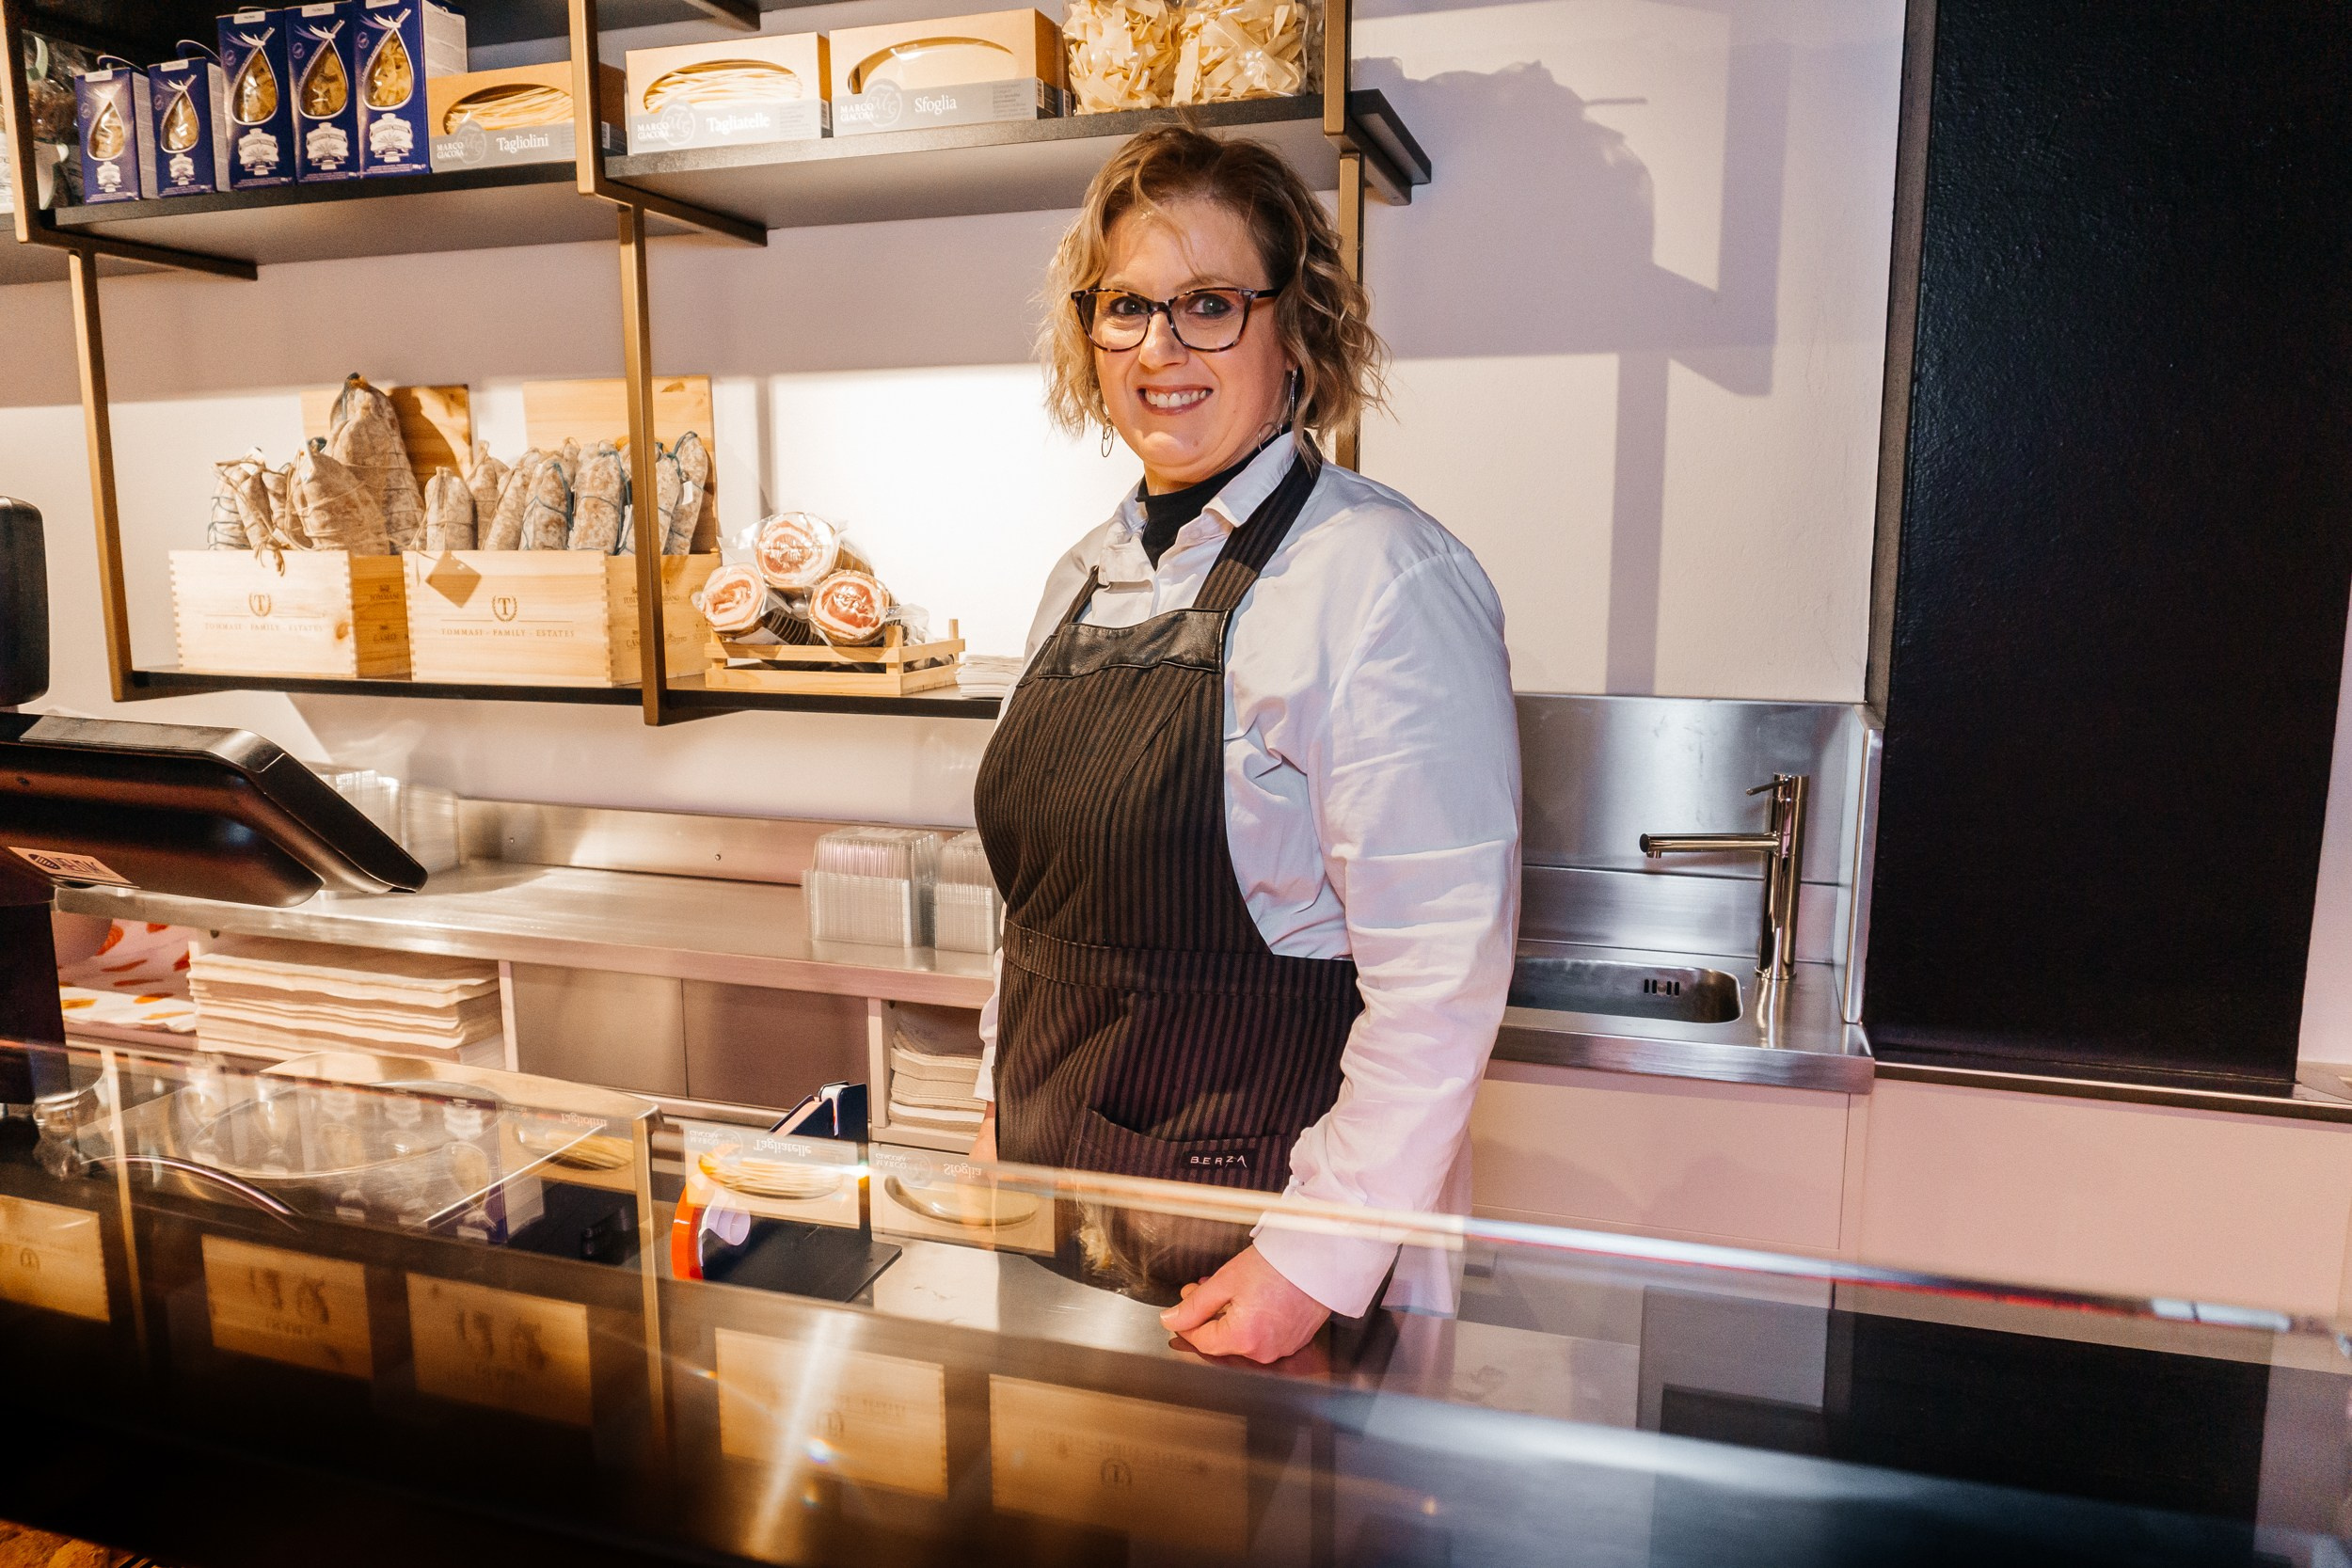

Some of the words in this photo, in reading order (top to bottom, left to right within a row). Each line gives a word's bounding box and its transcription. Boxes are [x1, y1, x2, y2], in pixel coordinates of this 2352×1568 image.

[840, 103, 873, 113] MARCO
[914, 94, 958, 115] Sfoglia
[637, 121, 669, 132] MARCO
[706, 112, 771, 135] Tagliatelle
[437, 142, 464, 151] MARCO
[496, 134, 548, 154] Tagliolini
[498, 597, 511, 616] T
[289, 624, 324, 632] ESTATES
[536, 629, 575, 638] ESTATES
[1190, 1155, 1247, 1168] BERZA
